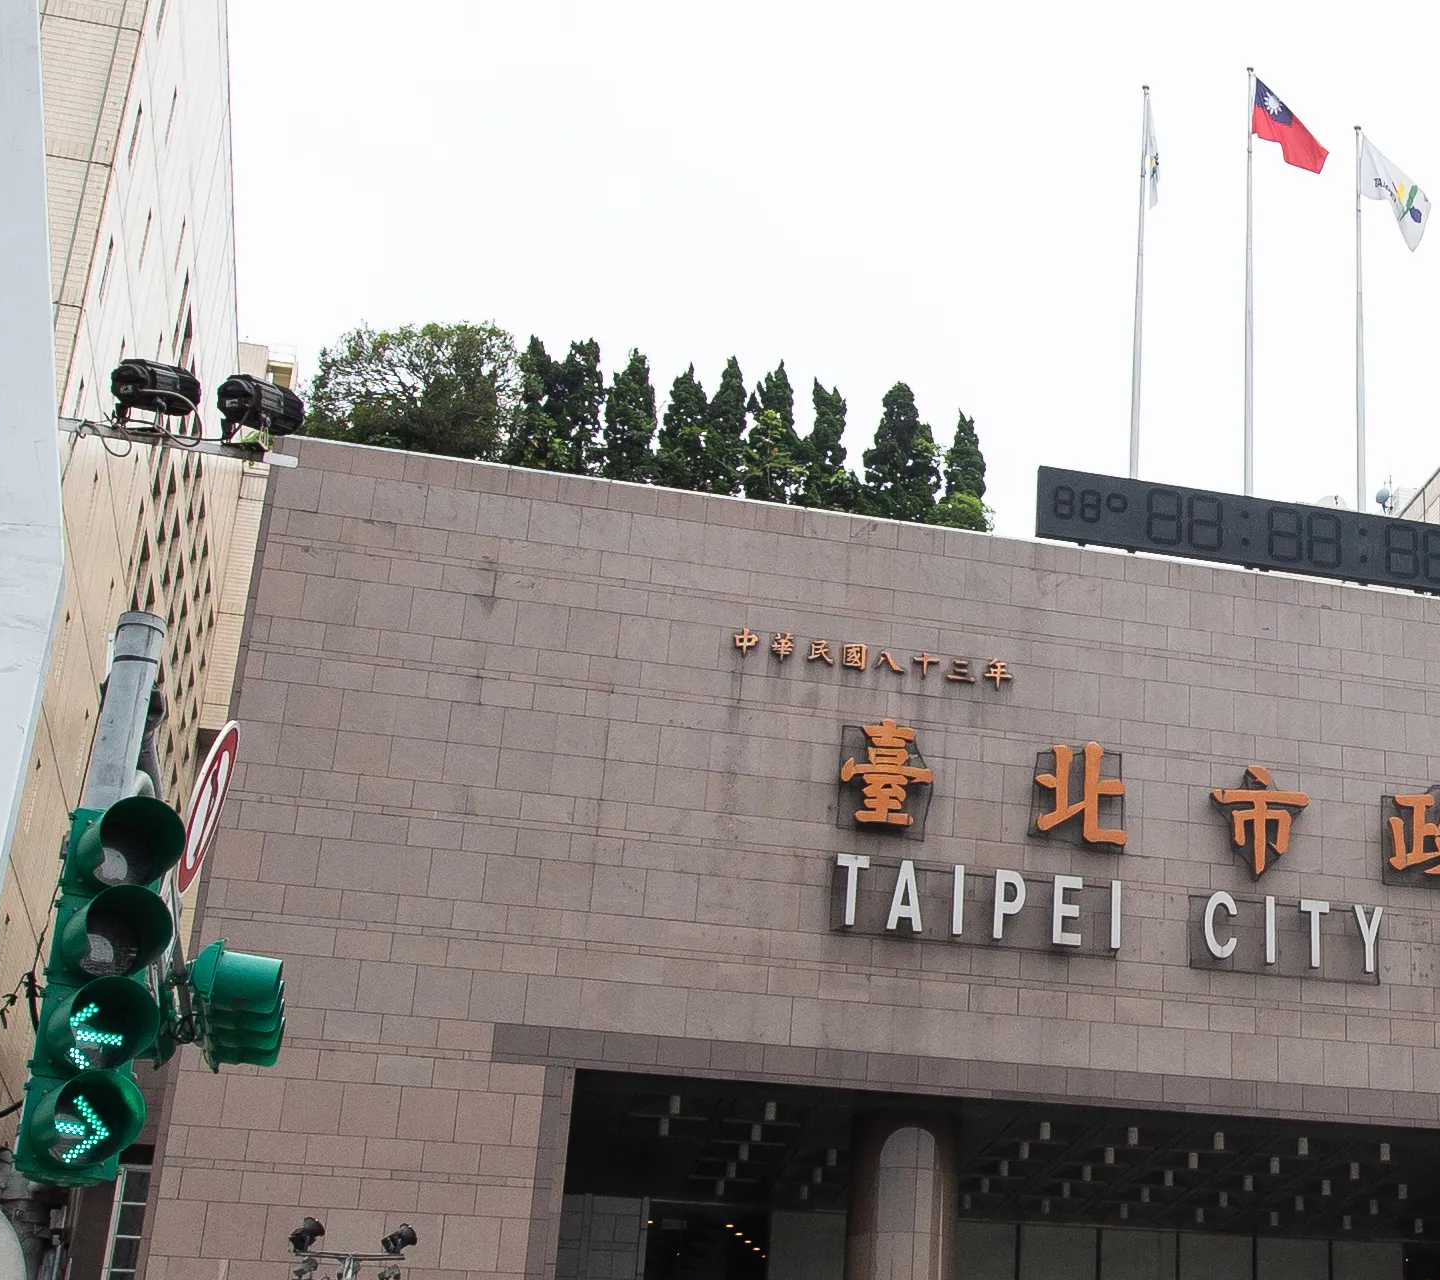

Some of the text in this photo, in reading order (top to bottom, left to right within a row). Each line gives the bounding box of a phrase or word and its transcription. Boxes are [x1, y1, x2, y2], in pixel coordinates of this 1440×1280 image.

[733, 627, 1013, 690] 中華民國八十三年
[837, 853, 1122, 950] TAIPEI
[1203, 890, 1384, 974] CITY
